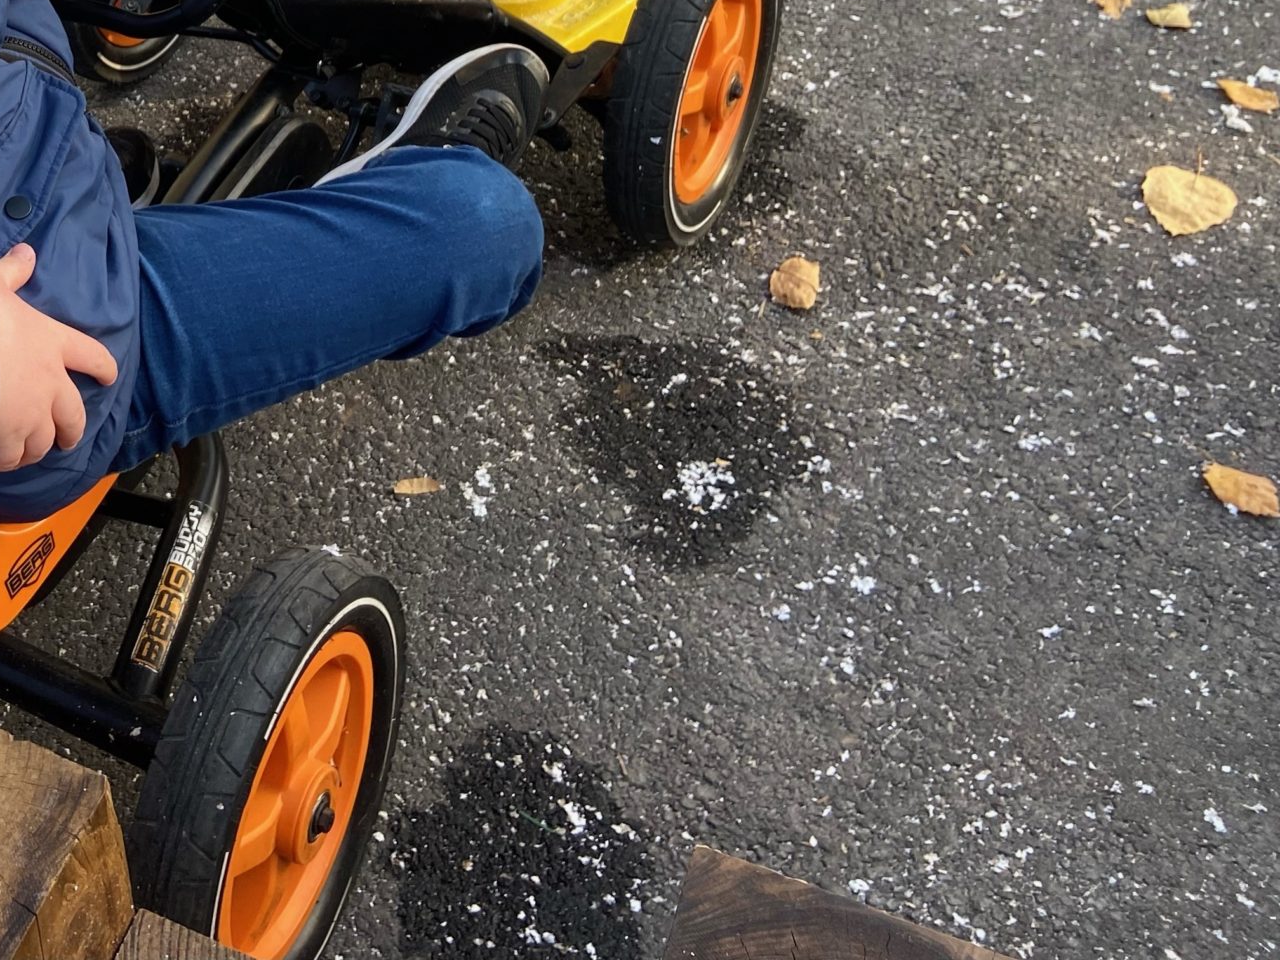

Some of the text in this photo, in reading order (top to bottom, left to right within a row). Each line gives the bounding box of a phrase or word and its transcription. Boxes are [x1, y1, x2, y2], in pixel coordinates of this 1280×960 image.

[170, 504, 202, 565] BUDDY
[8, 538, 53, 593] BERG
[134, 565, 194, 669] BERG
